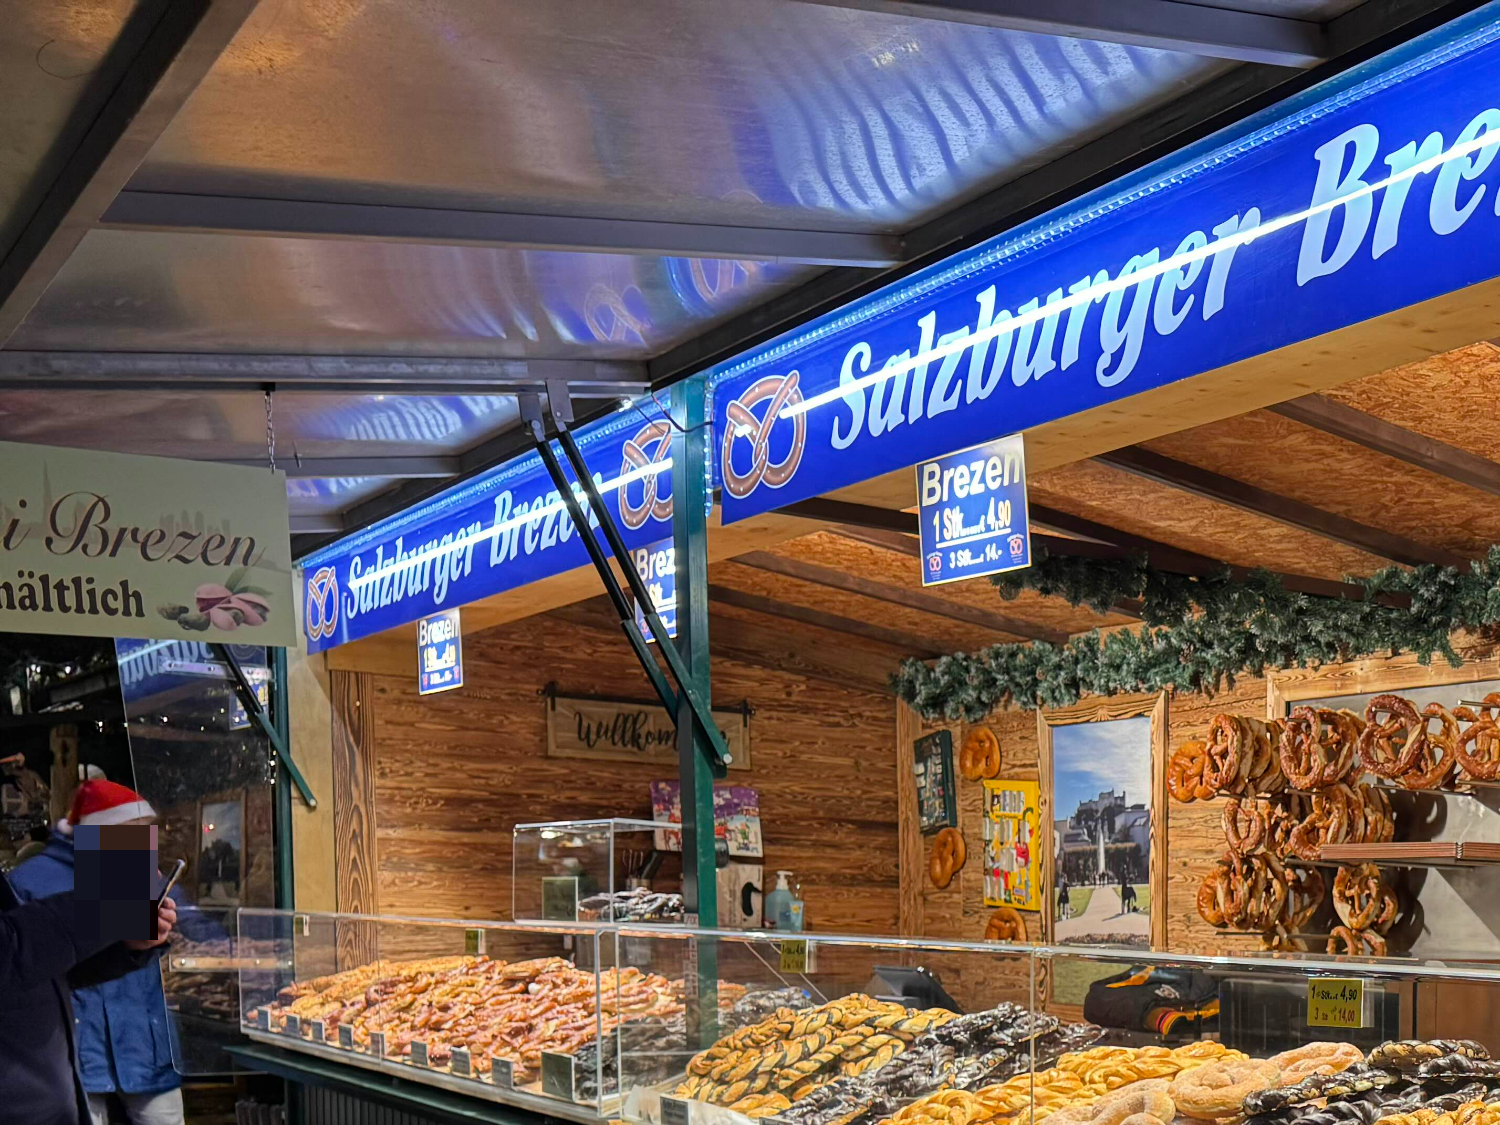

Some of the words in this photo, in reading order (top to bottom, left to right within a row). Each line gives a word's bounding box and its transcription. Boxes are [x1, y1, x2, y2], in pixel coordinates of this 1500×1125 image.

[830, 206, 1262, 449] Salzburger
[922, 453, 1020, 507] Brezen
[45, 491, 266, 568] Brezen
[933, 510, 940, 542] 1
[987, 497, 1011, 531] 4,90
[347, 519, 481, 619] Salzburger
[636, 547, 676, 581] Brez
[949, 552, 955, 569] 3
[1311, 985, 1316, 999] 1
[1340, 985, 1357, 1003] 4,90
